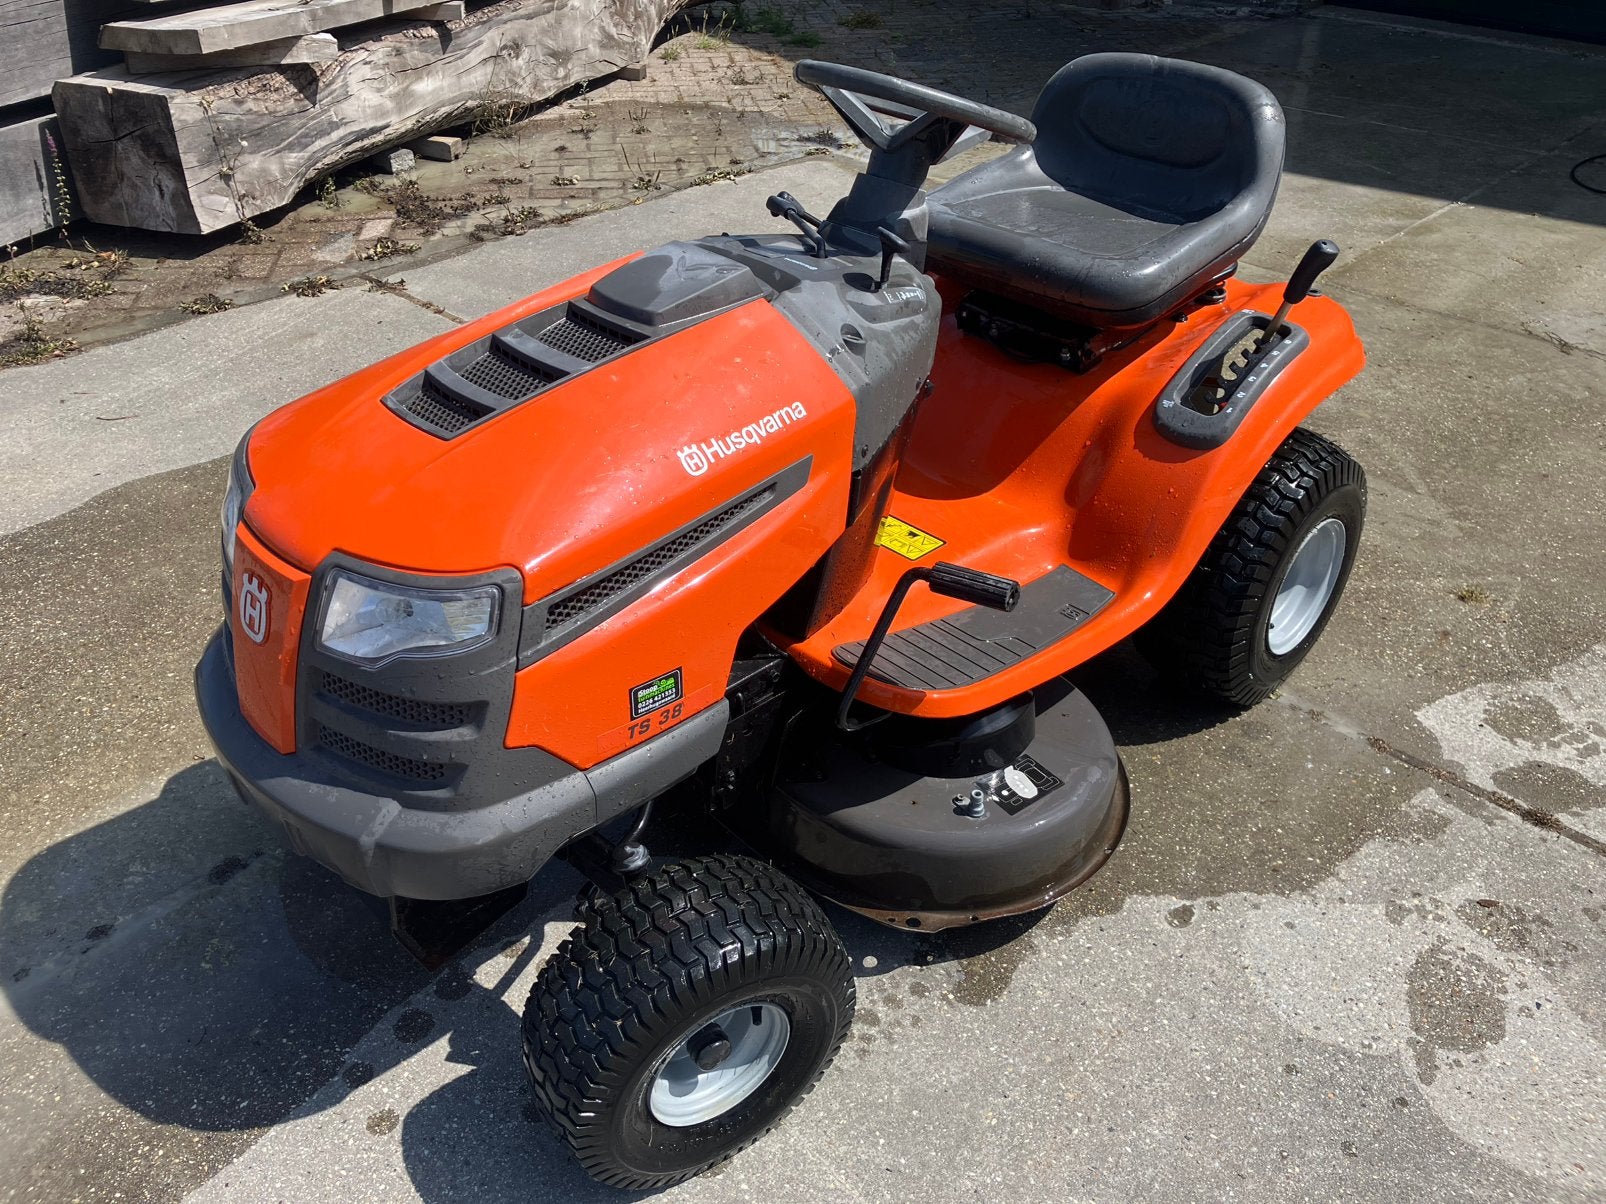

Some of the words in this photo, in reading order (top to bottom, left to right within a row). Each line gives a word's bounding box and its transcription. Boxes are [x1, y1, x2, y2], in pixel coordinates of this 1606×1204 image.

[700, 401, 807, 463] Husqvarna
[628, 718, 651, 739] TS
[658, 702, 683, 726] 38
